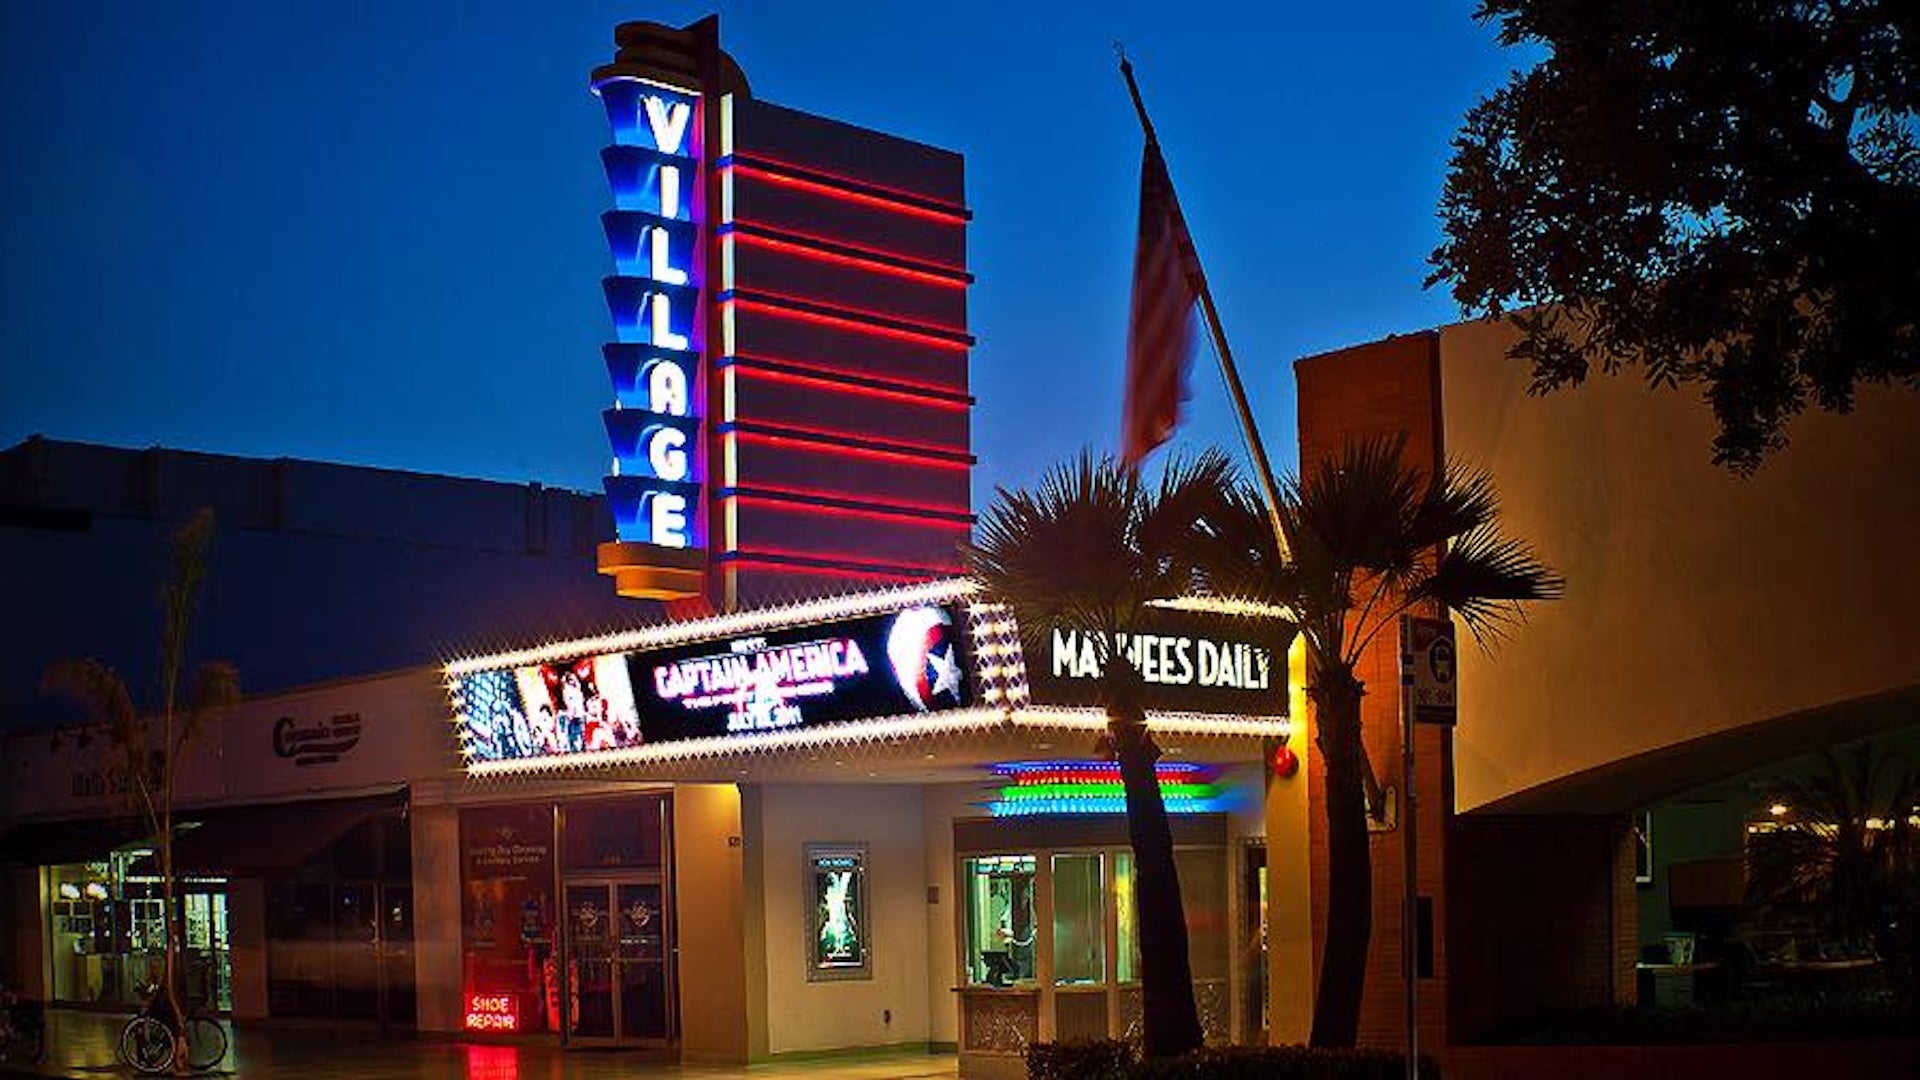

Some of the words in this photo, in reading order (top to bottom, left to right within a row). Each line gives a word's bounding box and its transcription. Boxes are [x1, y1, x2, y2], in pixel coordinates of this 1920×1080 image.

[643, 95, 691, 549] VILLAGE
[654, 655, 752, 698] CAPTAIN
[755, 638, 869, 682] AMERICA
[1198, 638, 1270, 690] DAILY
[466, 1013, 516, 1030] REPAIR
[471, 995, 510, 1014] SHOE
